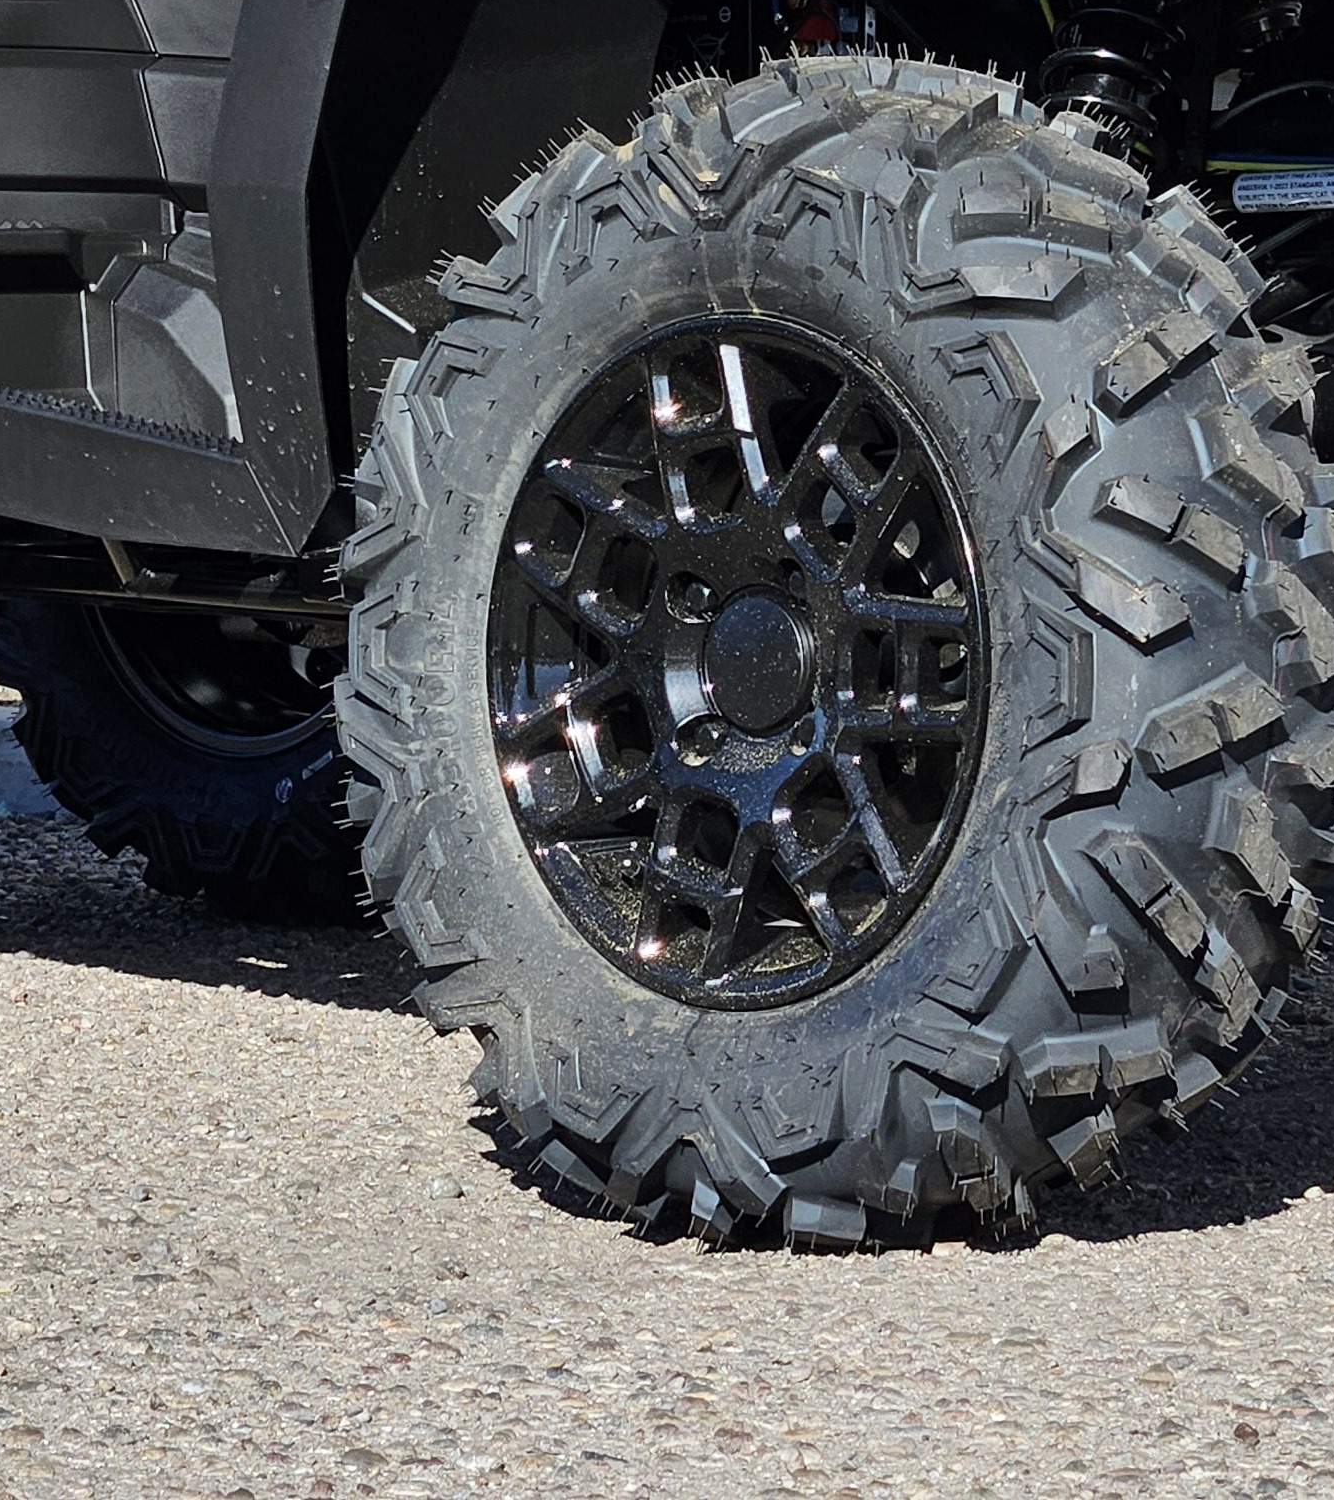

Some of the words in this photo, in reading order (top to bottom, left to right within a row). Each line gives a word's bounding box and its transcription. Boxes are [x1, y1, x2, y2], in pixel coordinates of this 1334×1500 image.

[1237, 194, 1265, 202] SUBJECT
[1277, 192, 1289, 200] THE
[1291, 191, 1314, 199] ARCTIC
[466, 628, 480, 690] SERVICE
[467, 696, 489, 763] HIGHWAY
[478, 767, 497, 794] FOR
[486, 801, 506, 828] NOT
